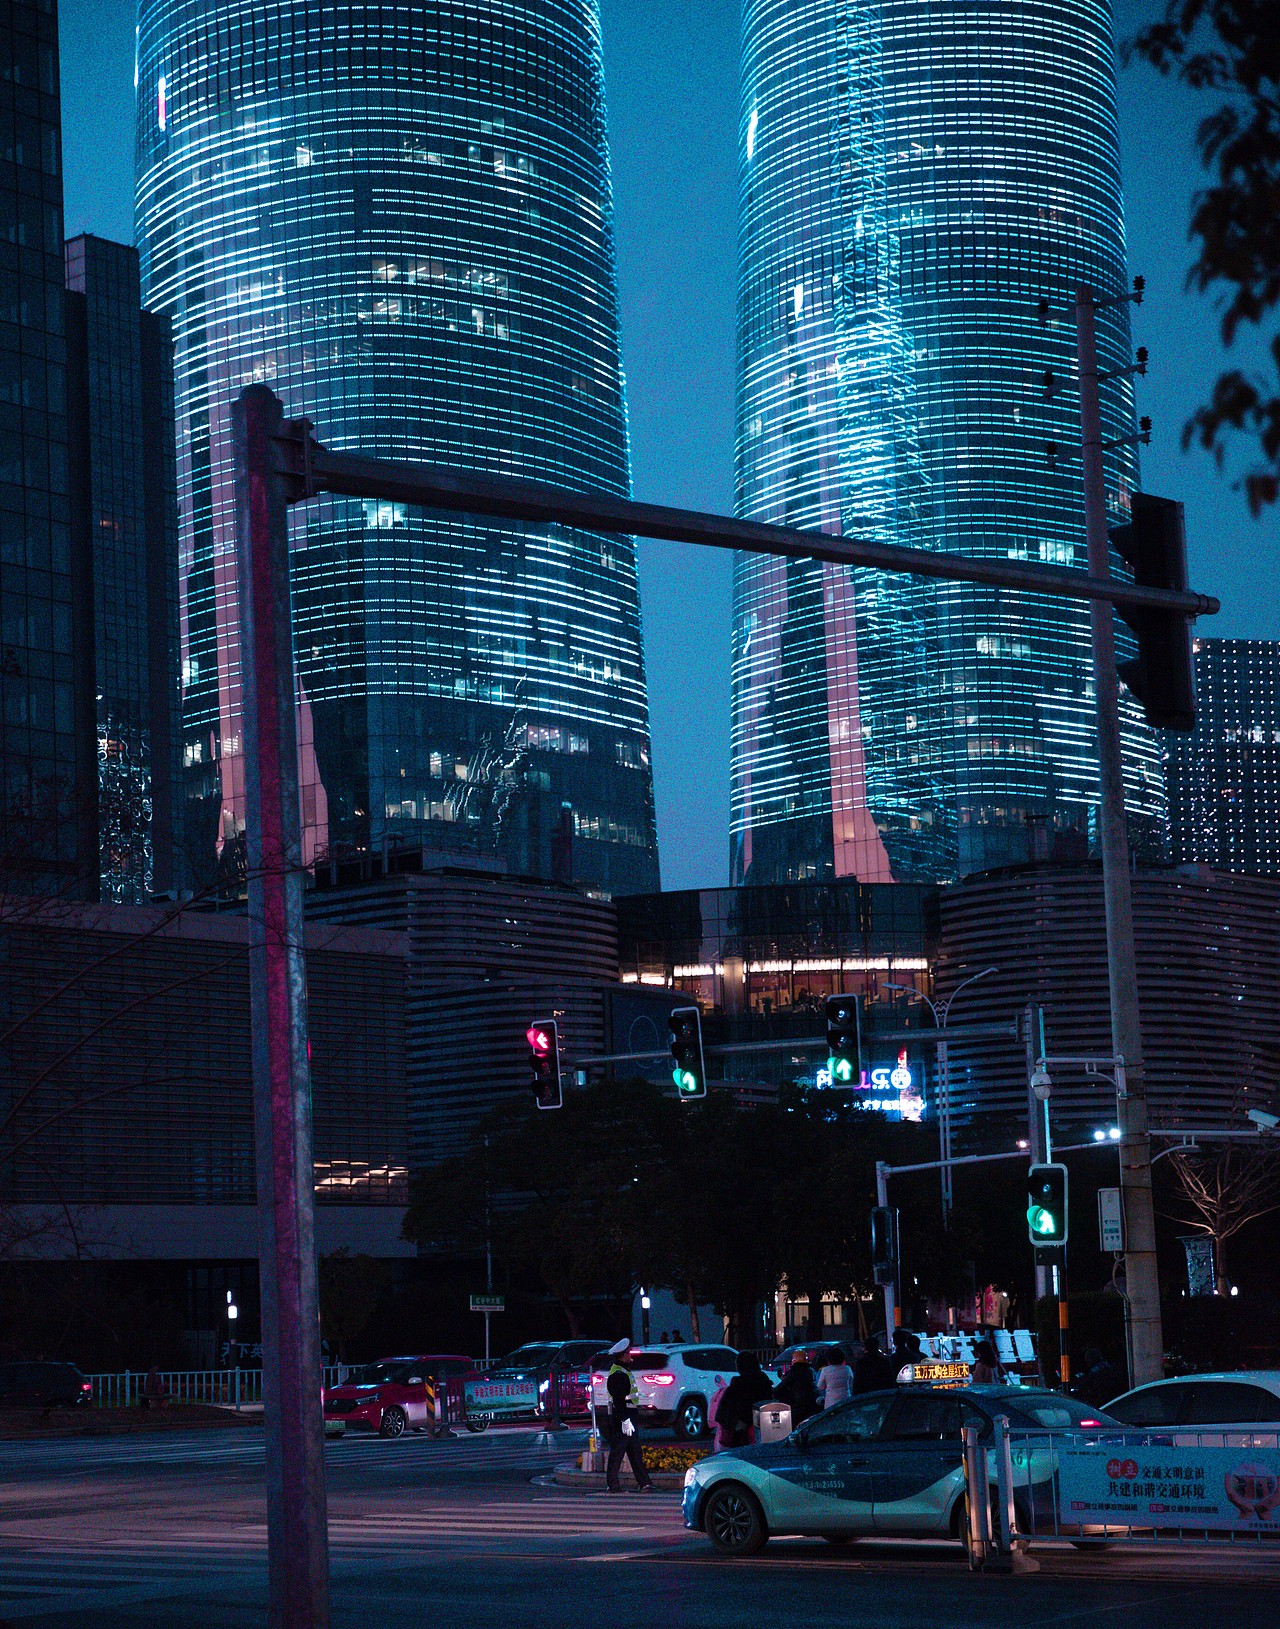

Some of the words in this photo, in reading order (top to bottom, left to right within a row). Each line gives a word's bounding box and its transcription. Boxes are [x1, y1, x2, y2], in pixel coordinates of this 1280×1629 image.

[1108, 1461, 1137, 1477] 树立
[1142, 1465, 1205, 1480] 交通文明意识
[1107, 1481, 1206, 1499] 共建和谐交通环境
